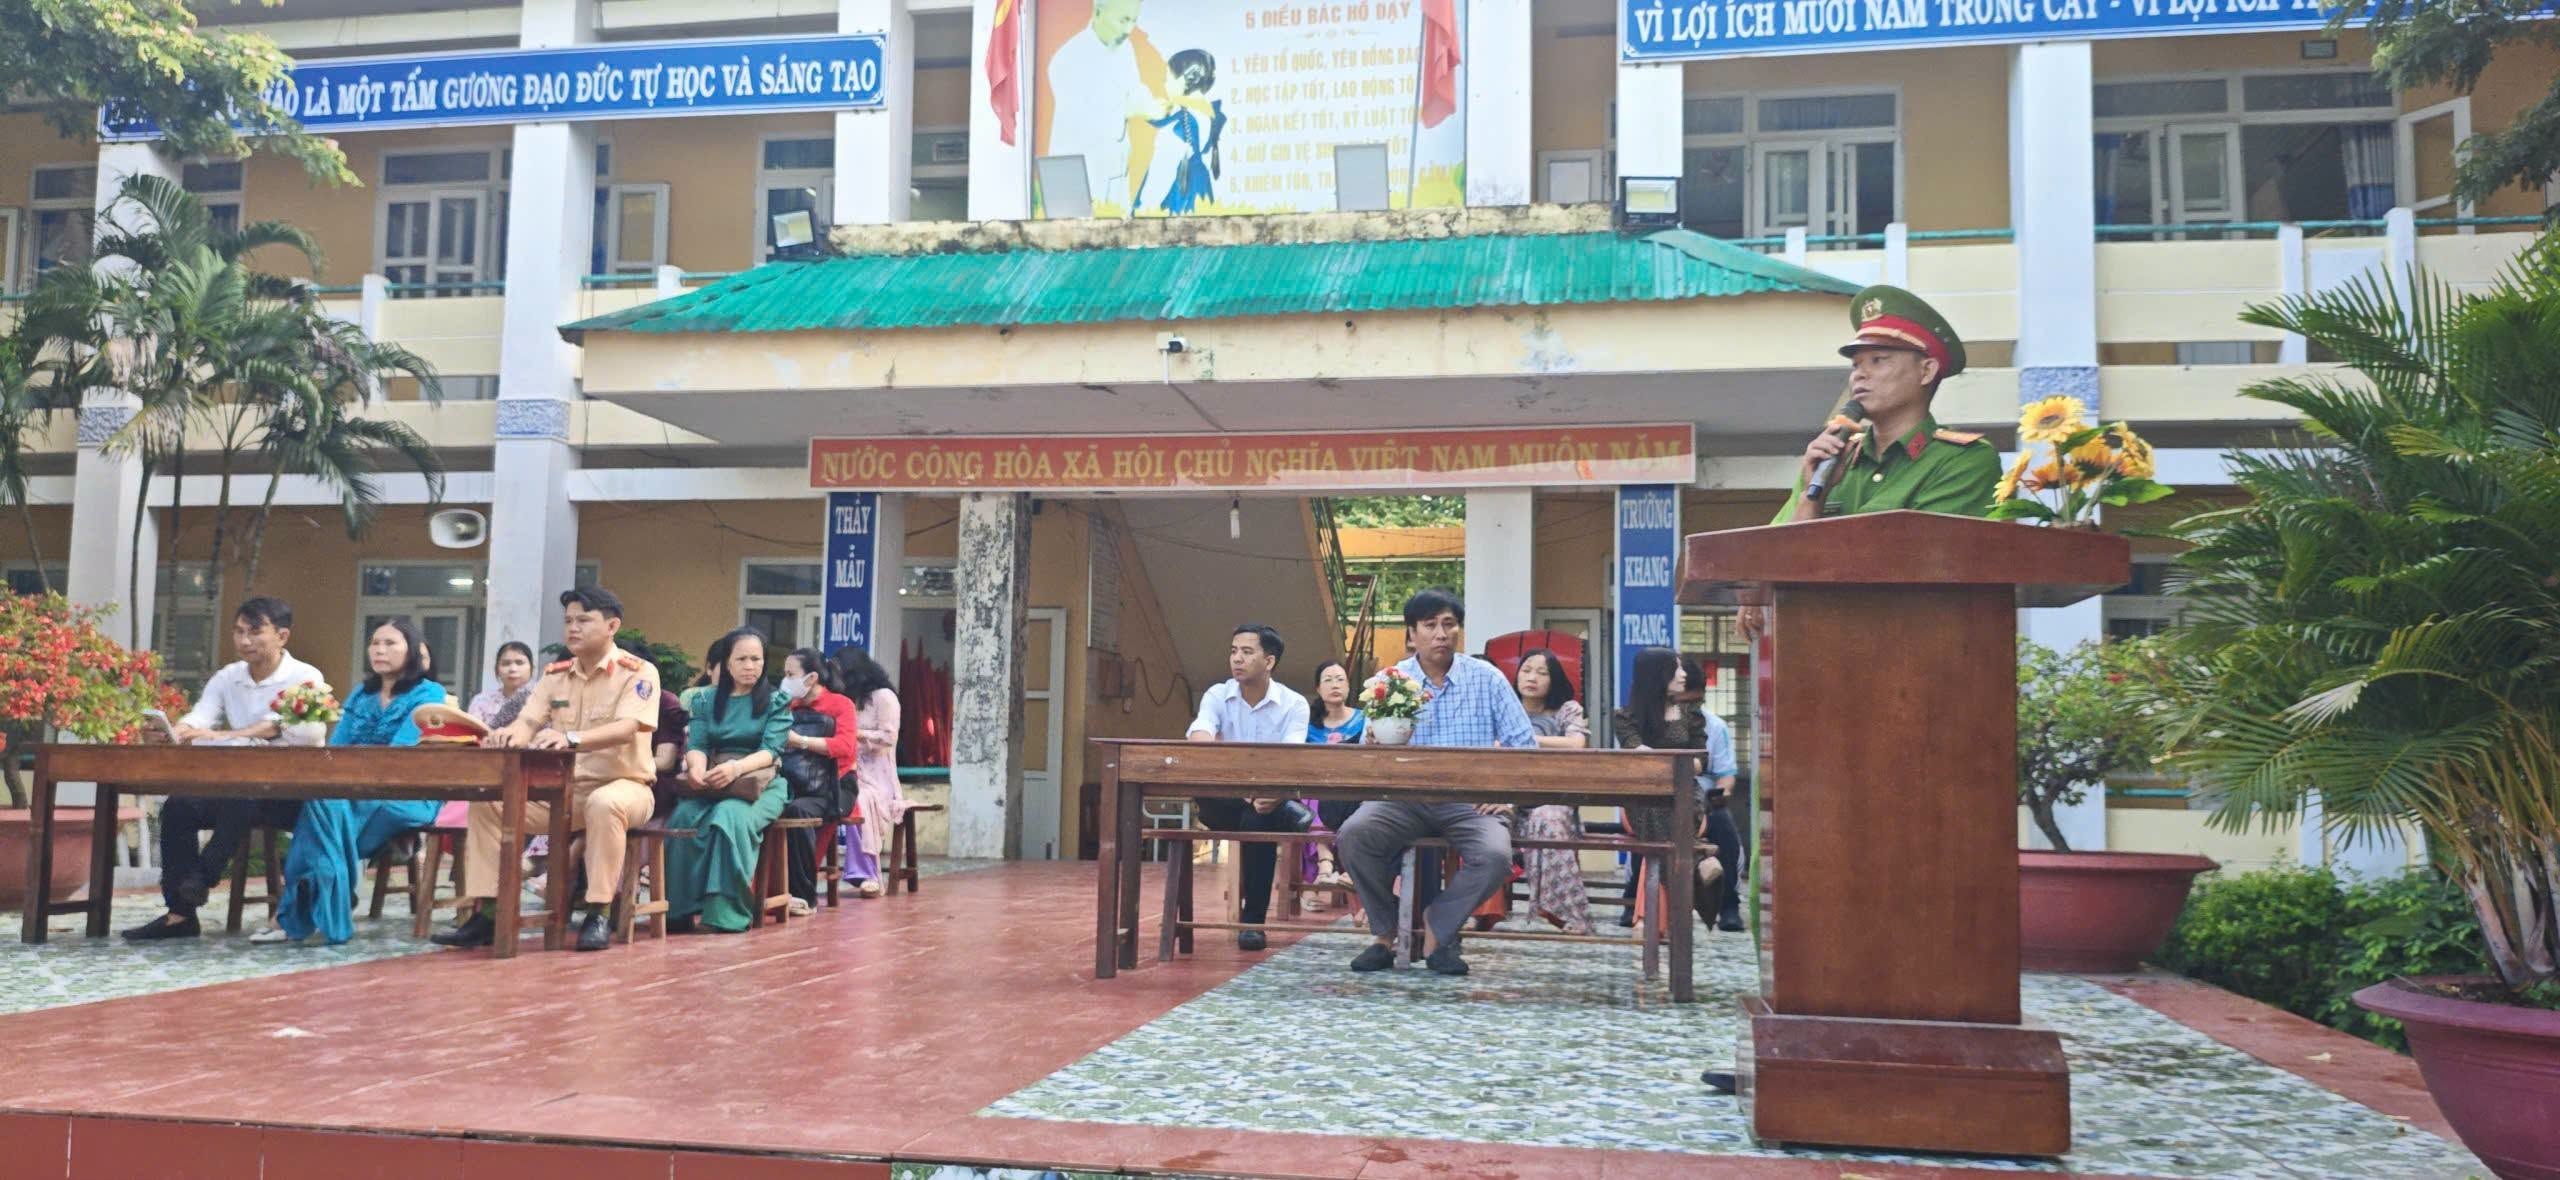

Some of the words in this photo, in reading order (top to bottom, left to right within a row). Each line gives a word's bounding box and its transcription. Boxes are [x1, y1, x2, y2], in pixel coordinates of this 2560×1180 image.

[1307, 3, 1342, 26] BÁC
[1635, 4, 1665, 43] VÌ
[1672, 3, 1718, 49] LỢI
[1725, 0, 1776, 39] ÍCH
[304, 76, 332, 116] LÀ
[337, 75, 385, 120] MỘT
[391, 65, 438, 112] TẤM
[443, 71, 518, 110] GƯƠNG
[523, 72, 569, 111] ĐẠO
[576, 62, 623, 103] ĐỨC
[631, 62, 662, 107] TỰ
[666, 64, 715, 106] HỌC
[721, 55, 754, 97] VÀ
[760, 54, 822, 95] SÁNG
[829, 59, 877, 99] TẠO
[820, 445, 896, 481] NƯỚC
[905, 445, 984, 485] CỘNG
[993, 444, 1053, 480] HÒA
[1061, 444, 1103, 480] XÃ
[1112, 443, 1166, 485] HỘI
[1174, 439, 1235, 478] CHỦ
[1245, 441, 1337, 478] NGHĨA
[1431, 444, 1498, 474] NAM
[1508, 436, 1600, 473] MUÔN
[1608, 433, 1683, 472] NĂM
[1624, 555, 1670, 587] KHANG
[830, 609, 864, 646] MỰC,
[1623, 614, 1671, 646] TRANG,
